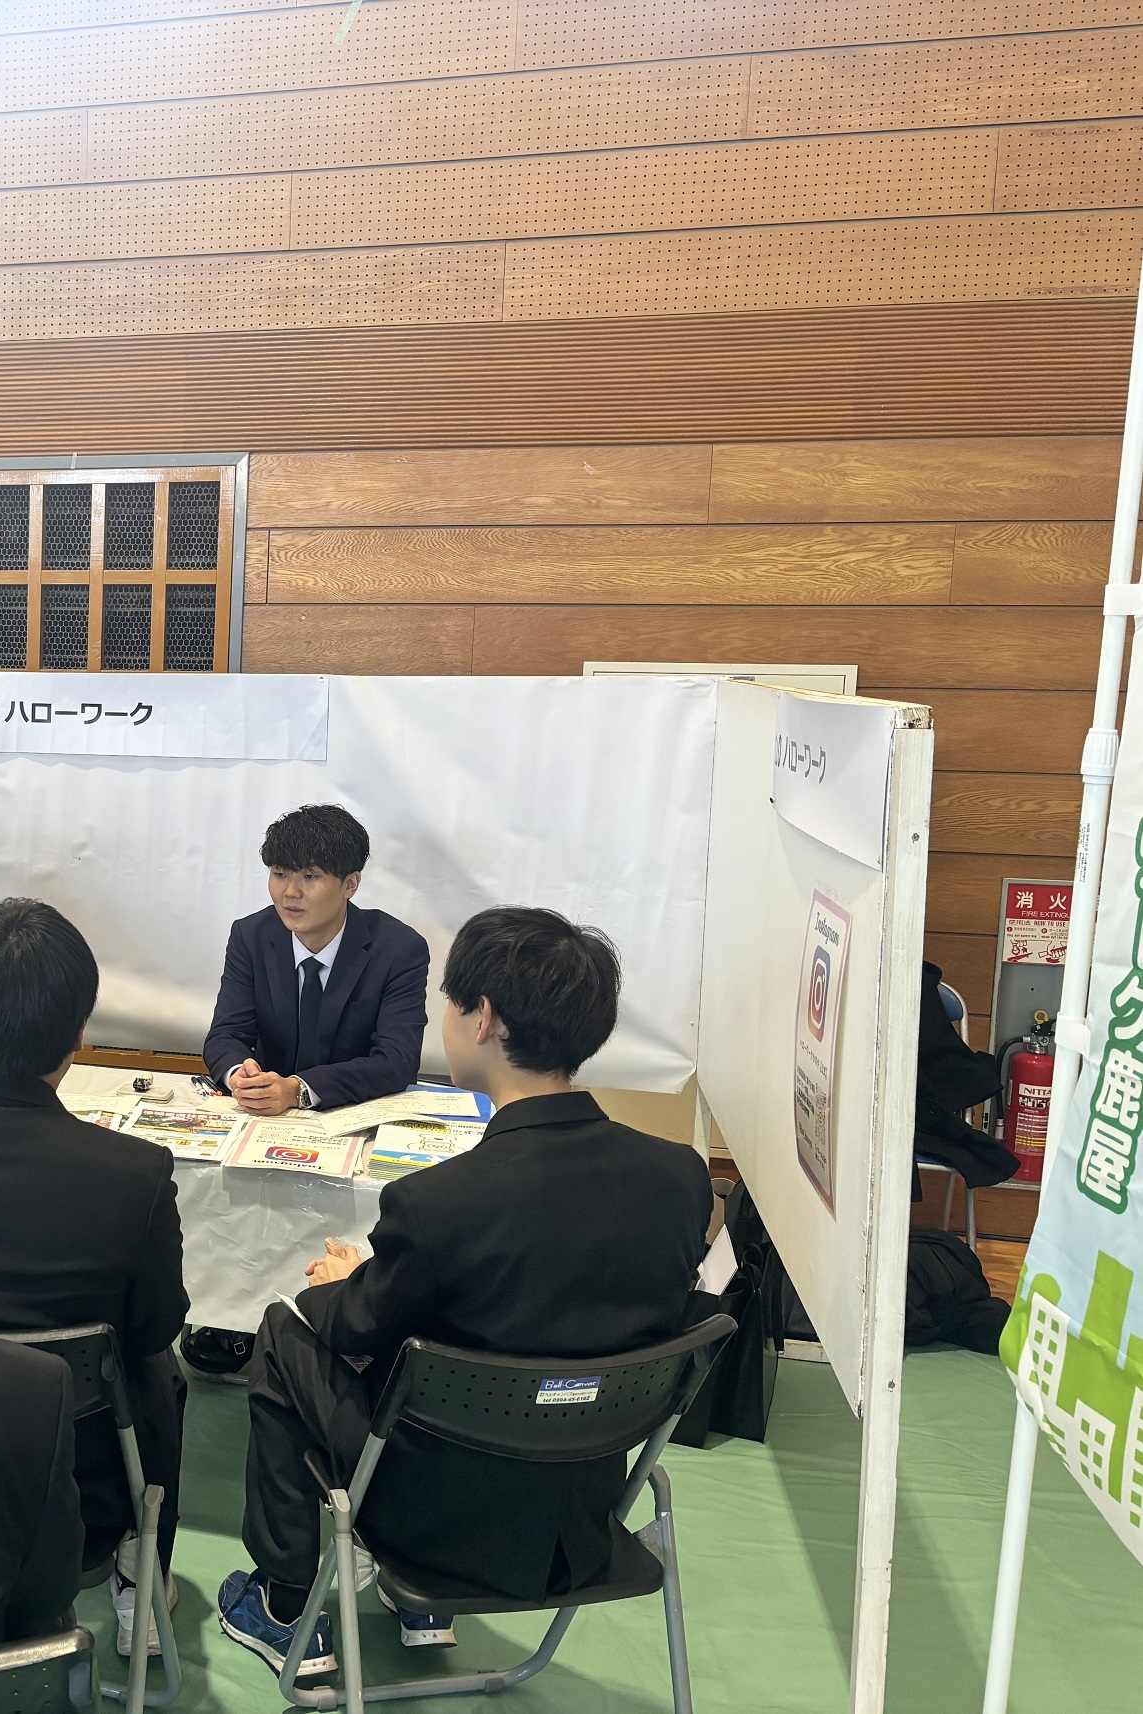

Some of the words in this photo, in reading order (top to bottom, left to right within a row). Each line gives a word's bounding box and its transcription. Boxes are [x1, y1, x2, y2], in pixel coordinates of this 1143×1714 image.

[4, 701, 153, 726] ハローワーク
[783, 736, 826, 784] ハローワーク
[1021, 910, 1039, 918] FIRE
[545, 1380, 563, 1389] Bell
[565, 1379, 597, 1389] Canvas
